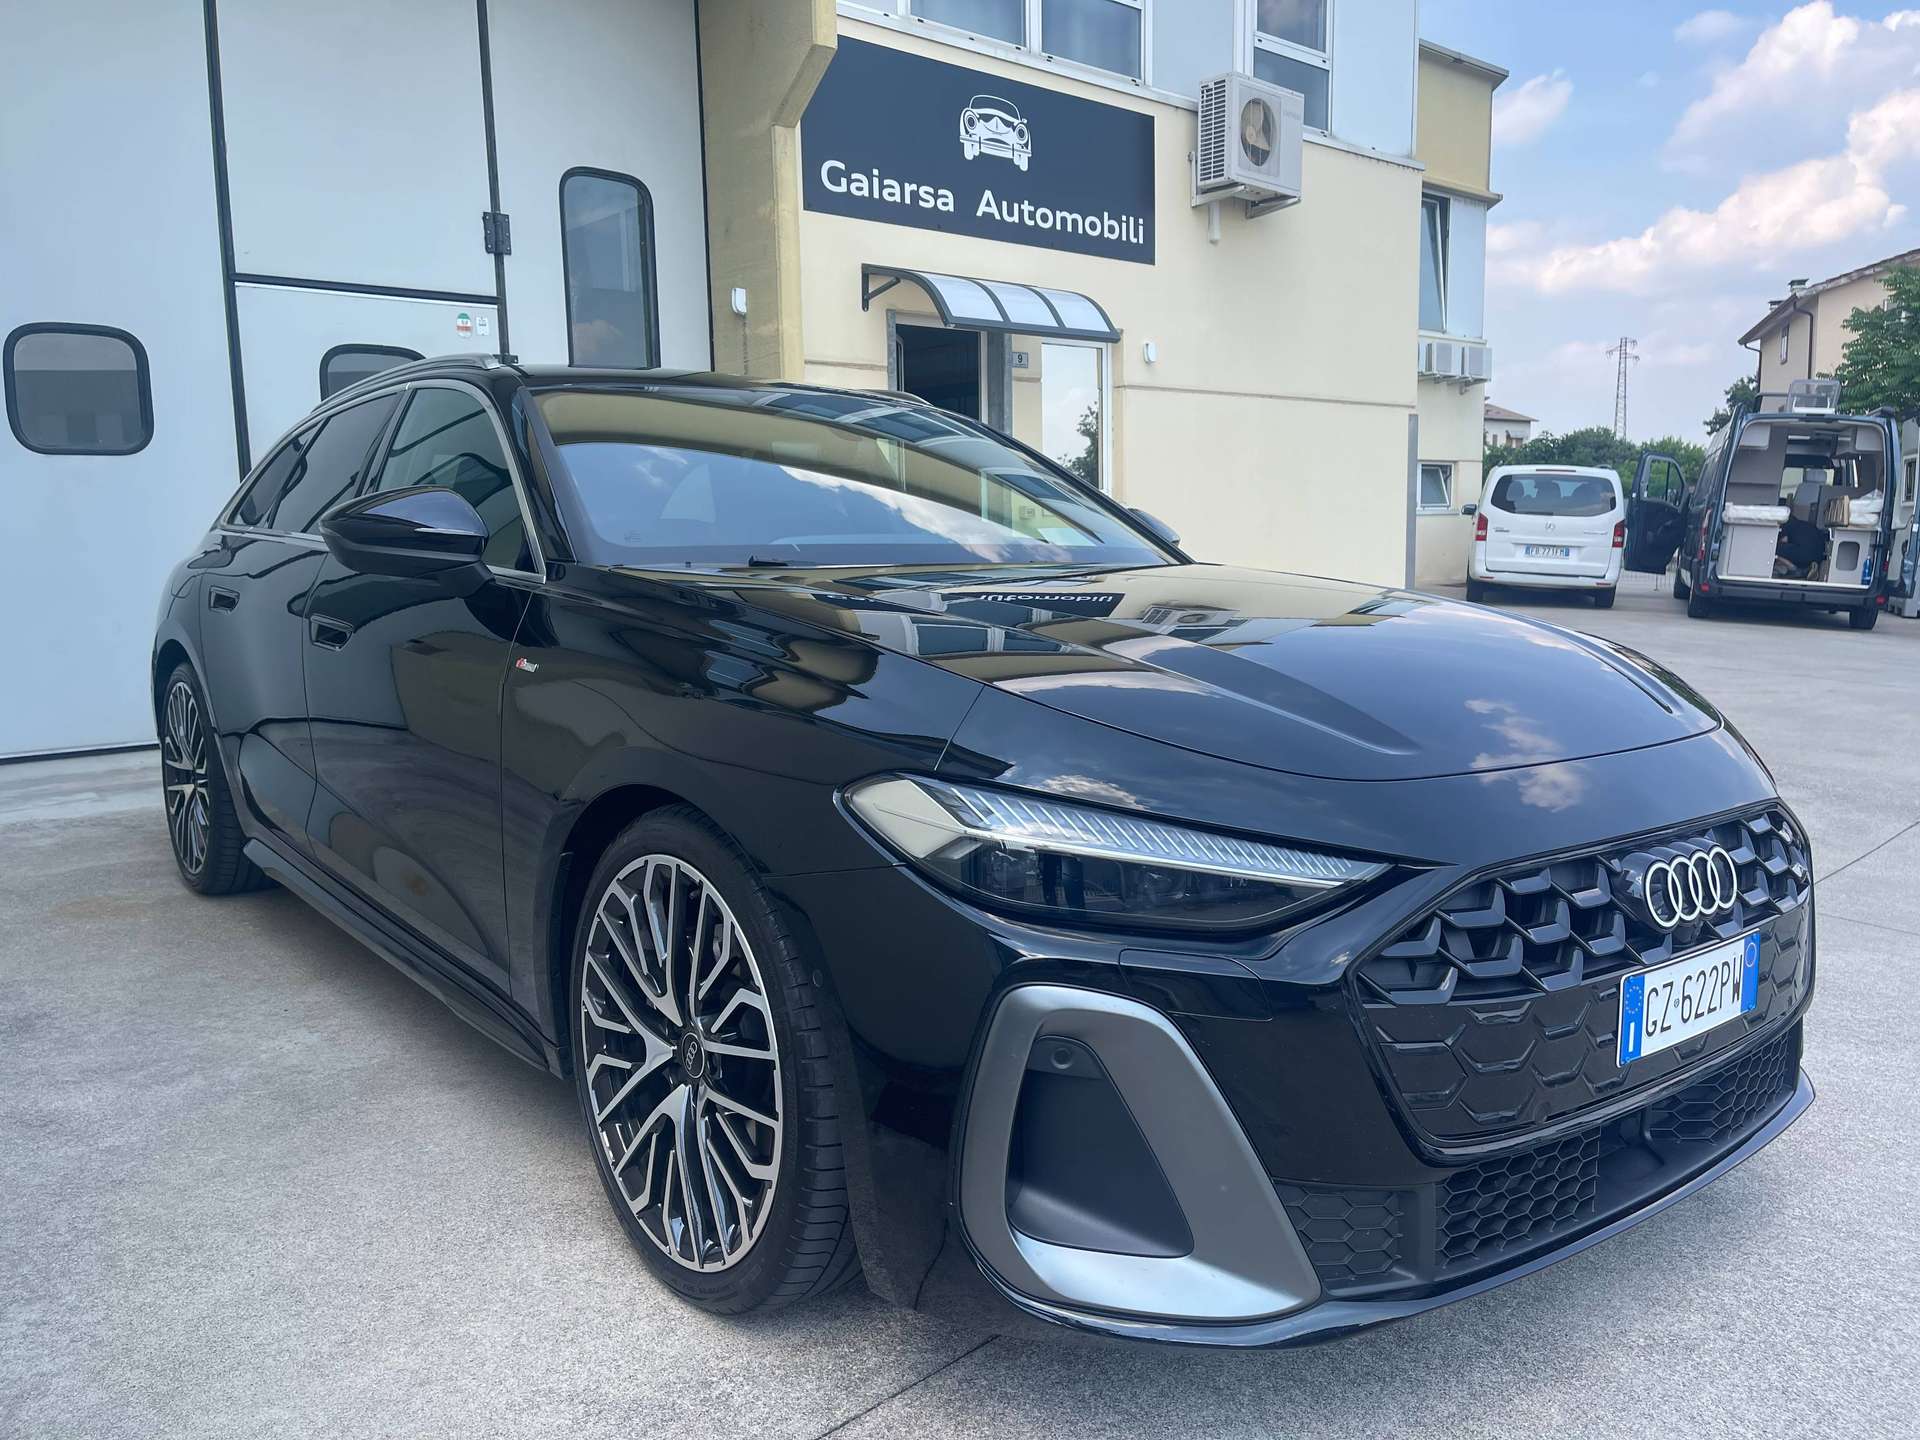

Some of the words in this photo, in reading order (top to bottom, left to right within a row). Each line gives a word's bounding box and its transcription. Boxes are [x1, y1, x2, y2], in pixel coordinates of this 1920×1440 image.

[820, 159, 955, 213] Gaiarsa
[976, 190, 1144, 244] Automobili
[1017, 353, 1023, 364] 9
[1645, 980, 1674, 1038] GZ
[1681, 954, 1743, 1024] 622PW
